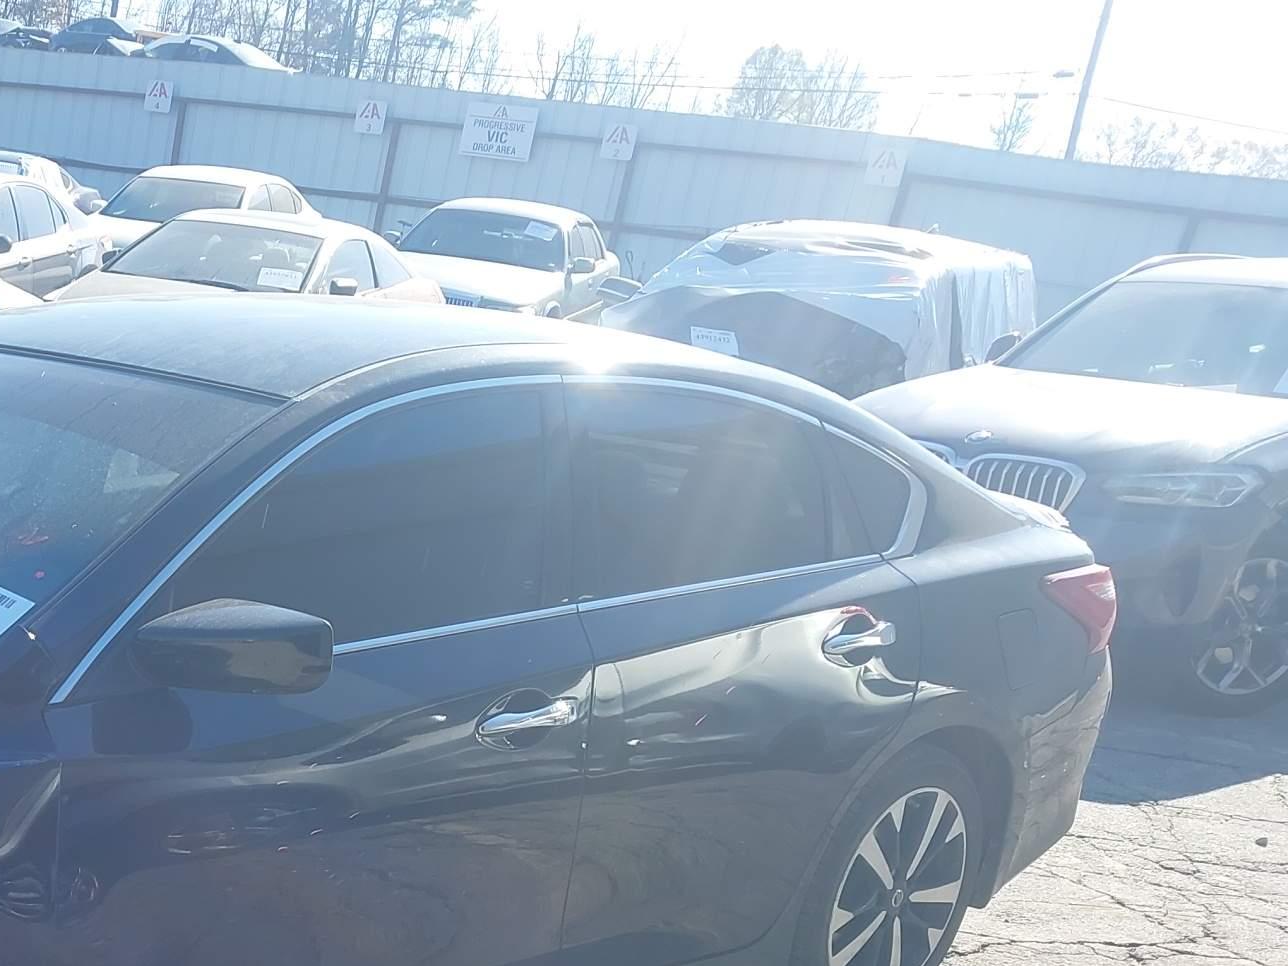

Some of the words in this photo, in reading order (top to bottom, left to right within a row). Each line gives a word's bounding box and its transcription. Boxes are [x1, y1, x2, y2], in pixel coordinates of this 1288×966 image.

[365, 123, 372, 132] 3
[473, 118, 526, 133] PROGRESSIVE
[486, 130, 509, 144] VIC
[472, 142, 495, 153] DROP
[495, 145, 516, 156] AREA
[612, 148, 620, 157] 2
